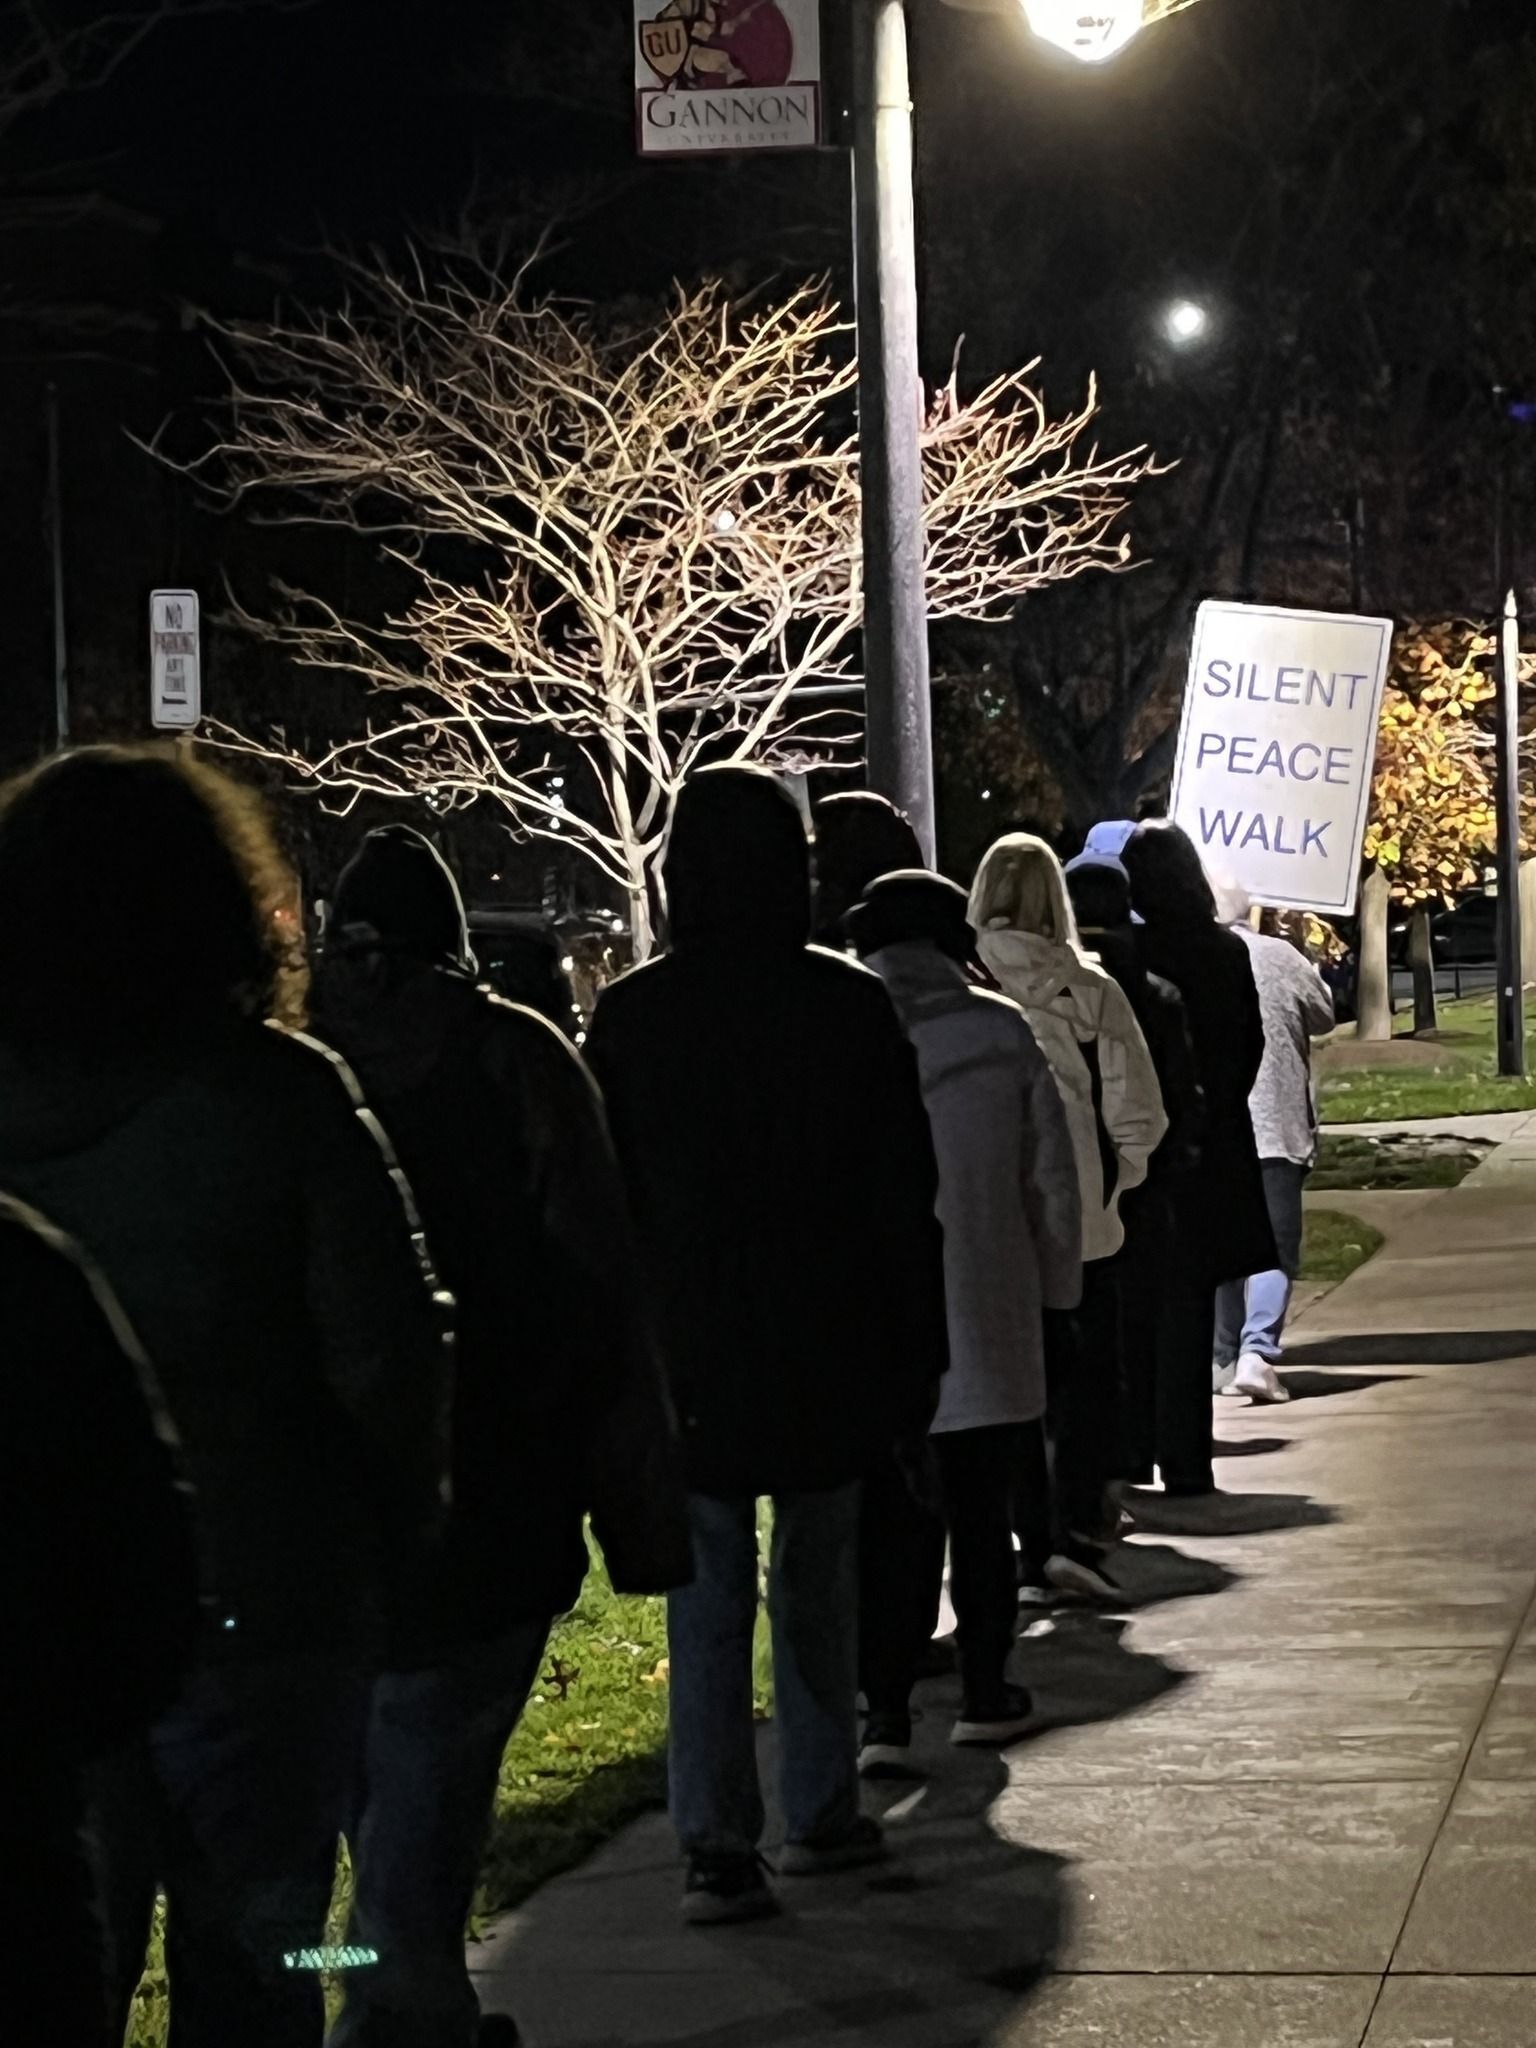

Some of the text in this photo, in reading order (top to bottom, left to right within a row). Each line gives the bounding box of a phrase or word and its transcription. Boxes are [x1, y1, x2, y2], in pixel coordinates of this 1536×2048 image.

[647, 28, 682, 57] GU
[647, 94, 809, 128] GANNON
[1203, 659, 1368, 710] SILENT
[1196, 733, 1353, 785] PEACE
[1198, 806, 1332, 858] WALK
